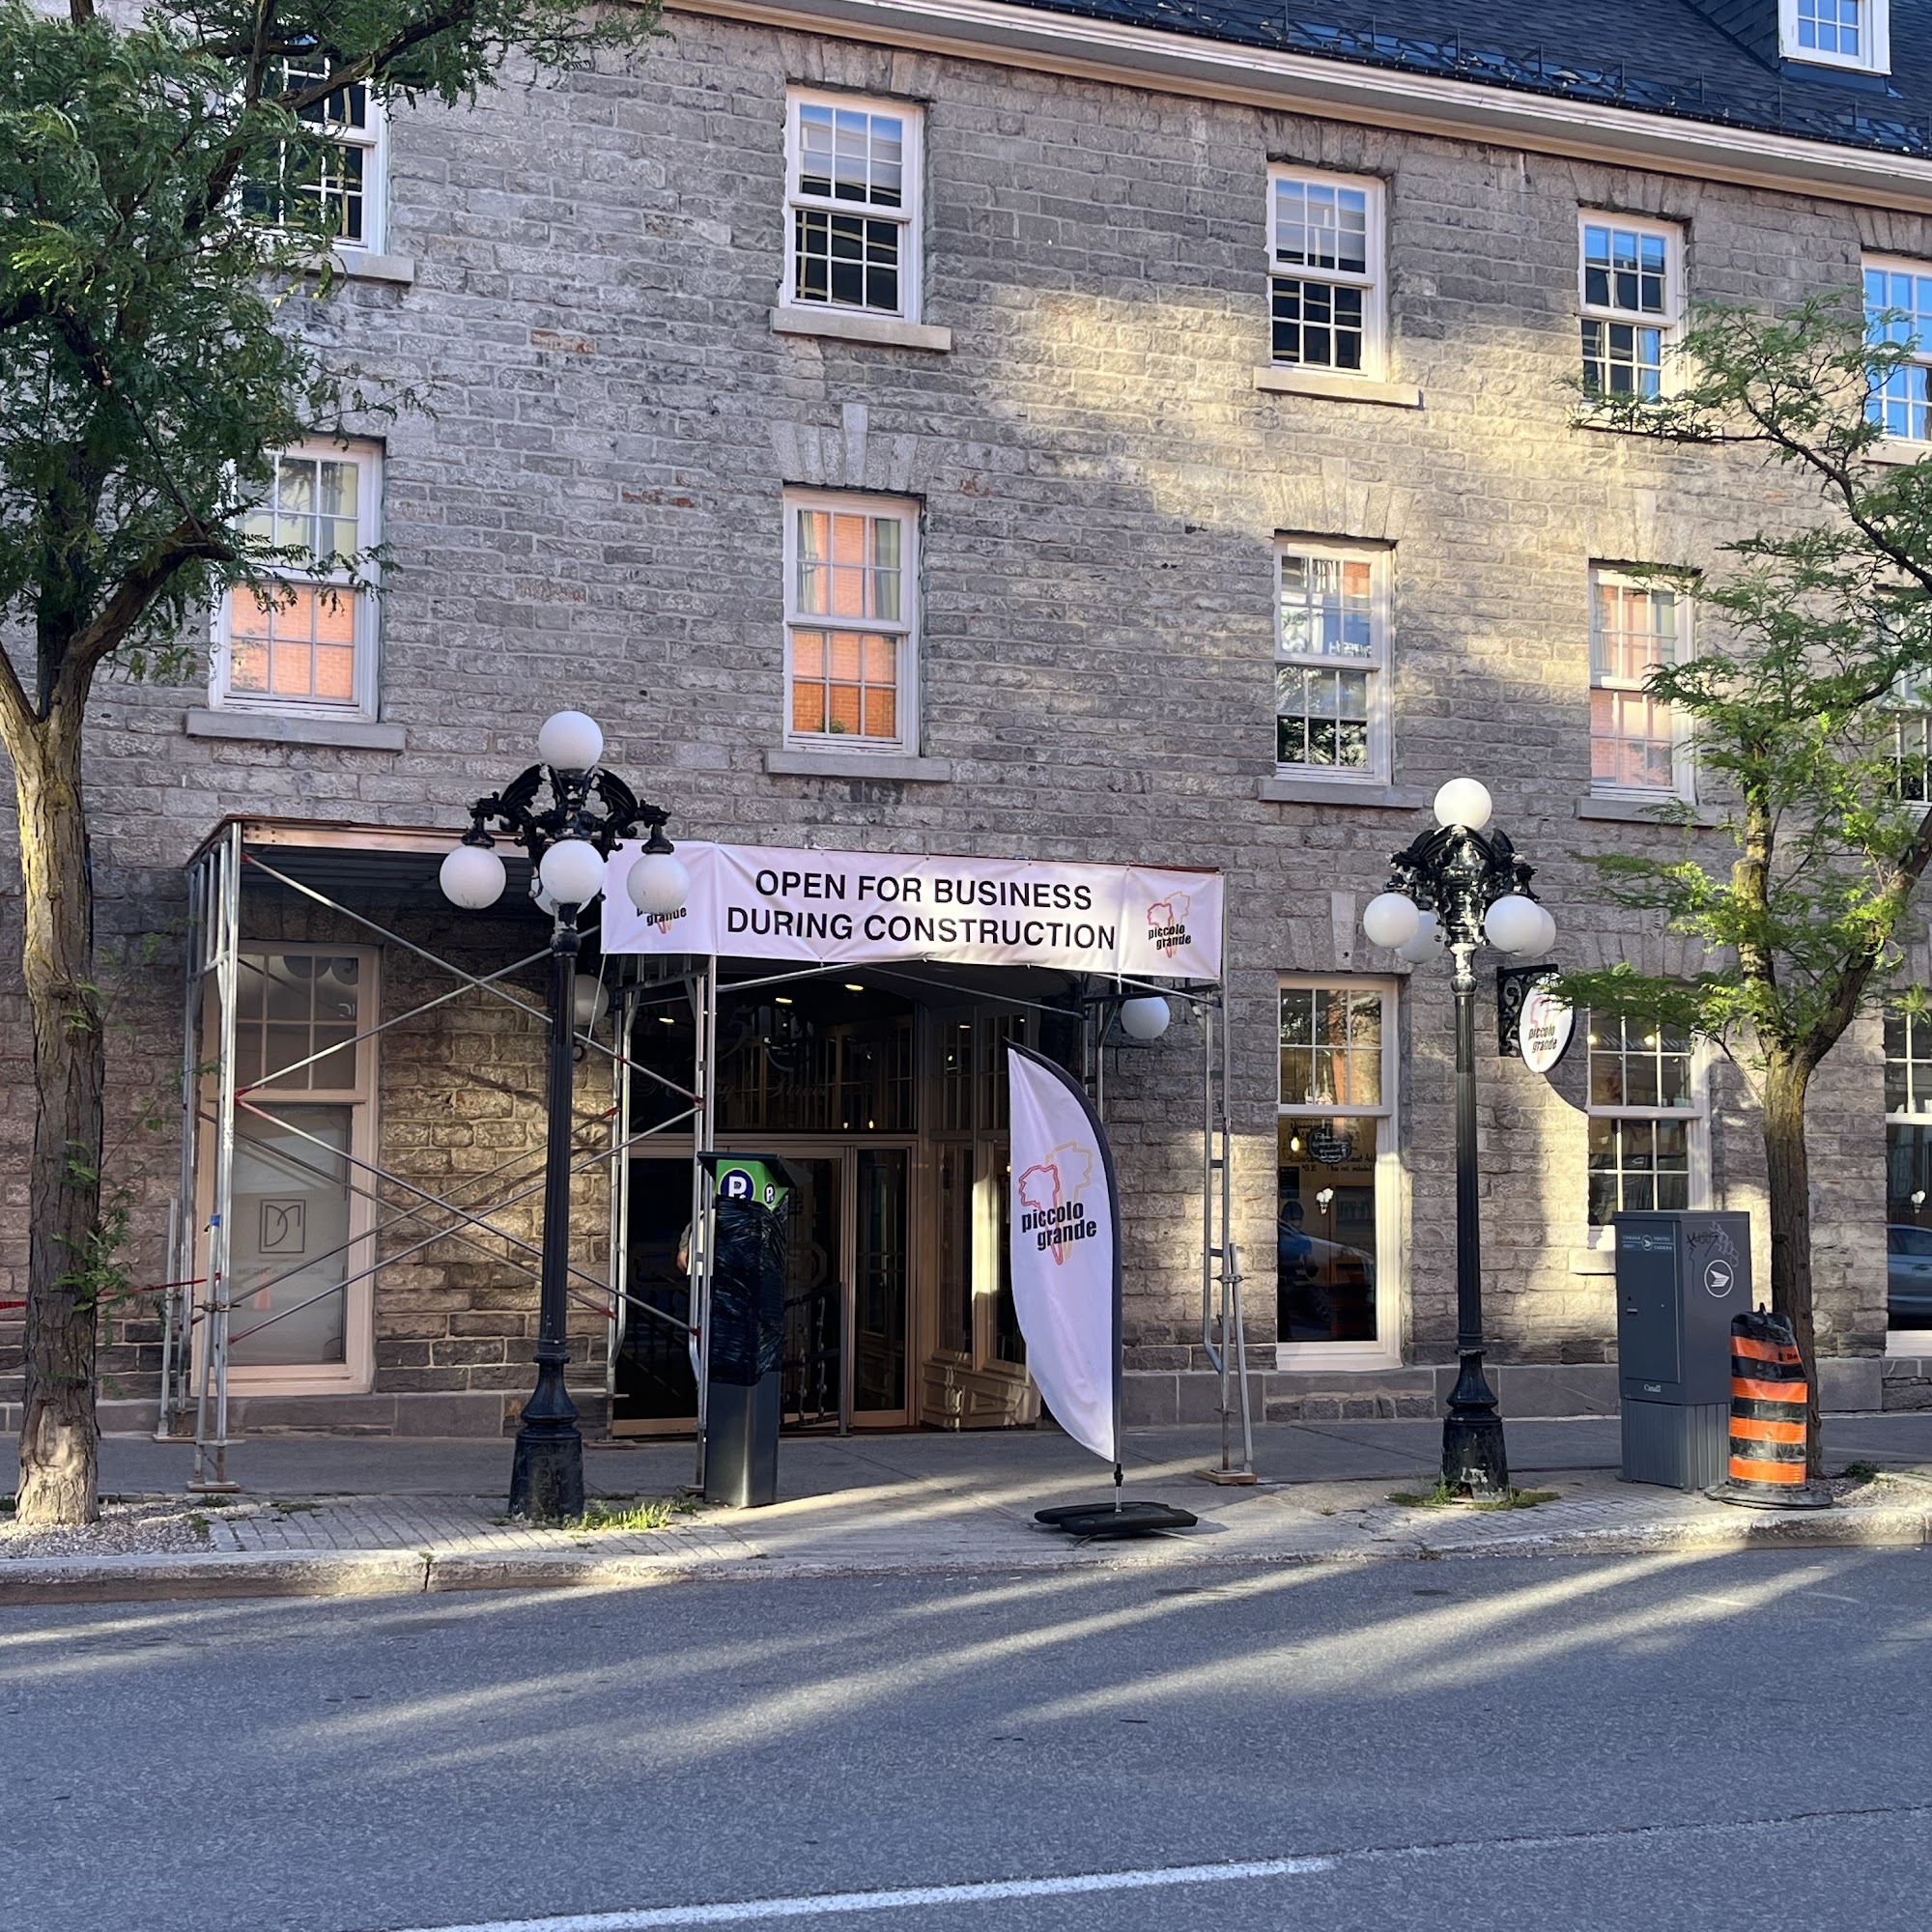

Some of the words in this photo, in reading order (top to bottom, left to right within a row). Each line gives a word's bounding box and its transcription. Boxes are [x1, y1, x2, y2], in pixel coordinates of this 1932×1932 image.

[756, 869, 846, 900] OPEN
[859, 875, 923, 902] FOR
[934, 878, 1093, 911] BUSINESS
[727, 906, 854, 940] DURING
[864, 914, 1116, 951] CONSTRUCTION
[1148, 923, 1186, 940] piccolo
[1156, 934, 1192, 951] grande
[1528, 1025, 1556, 1040] piccolo
[1532, 1038, 1558, 1053] grande
[1021, 1201, 1084, 1234] piccolo
[1037, 1219, 1097, 1251] grande
